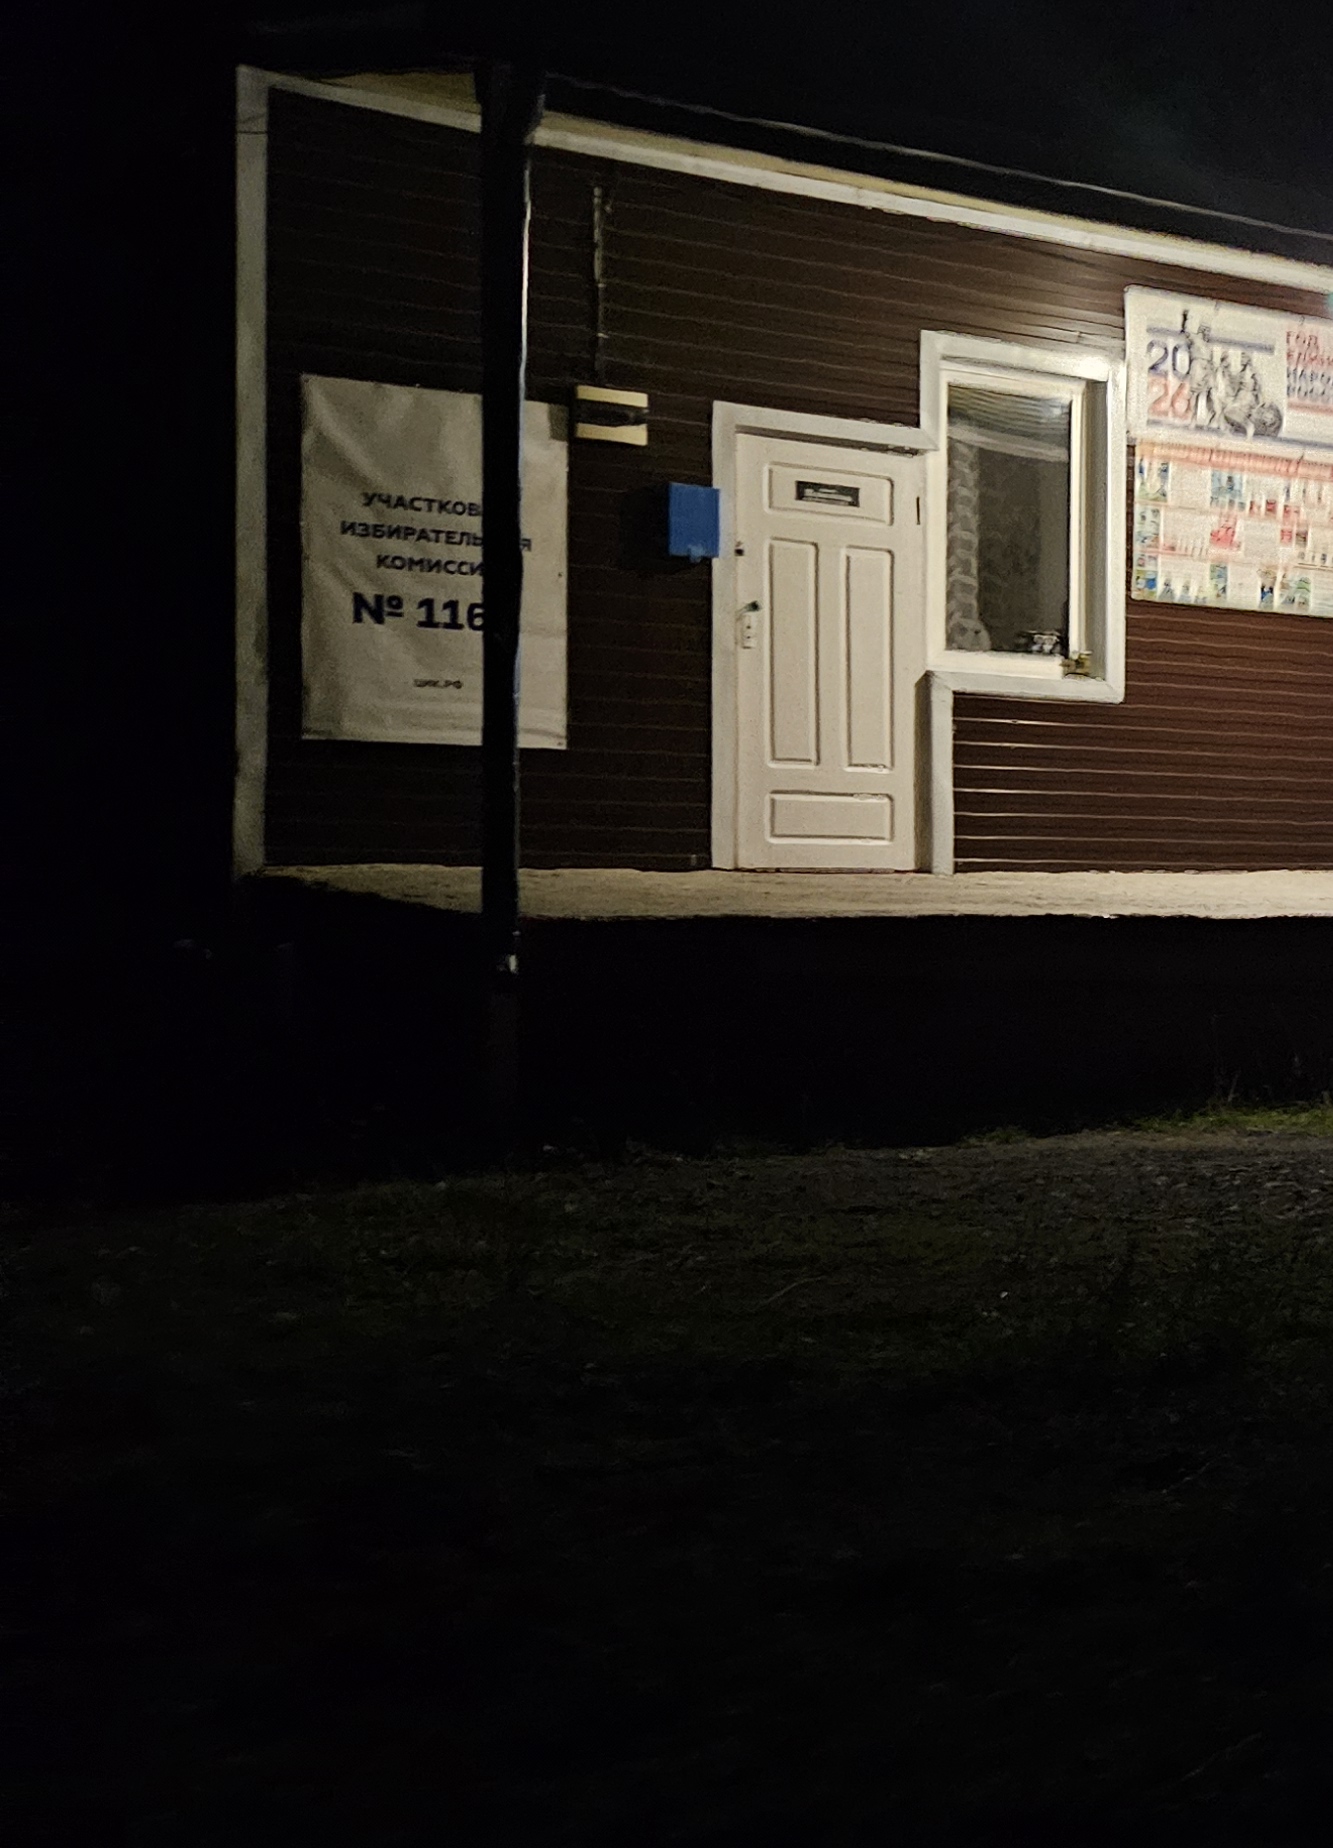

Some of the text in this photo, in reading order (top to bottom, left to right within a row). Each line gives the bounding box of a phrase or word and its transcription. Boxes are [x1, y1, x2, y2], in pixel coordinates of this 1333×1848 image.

[361, 492, 483, 517] УЧАСТКОВ
[339, 520, 533, 552] ИЗБИРАТЕЛЬЯ
[376, 554, 484, 576] КОМИССИ
[352, 591, 484, 631] № 116
